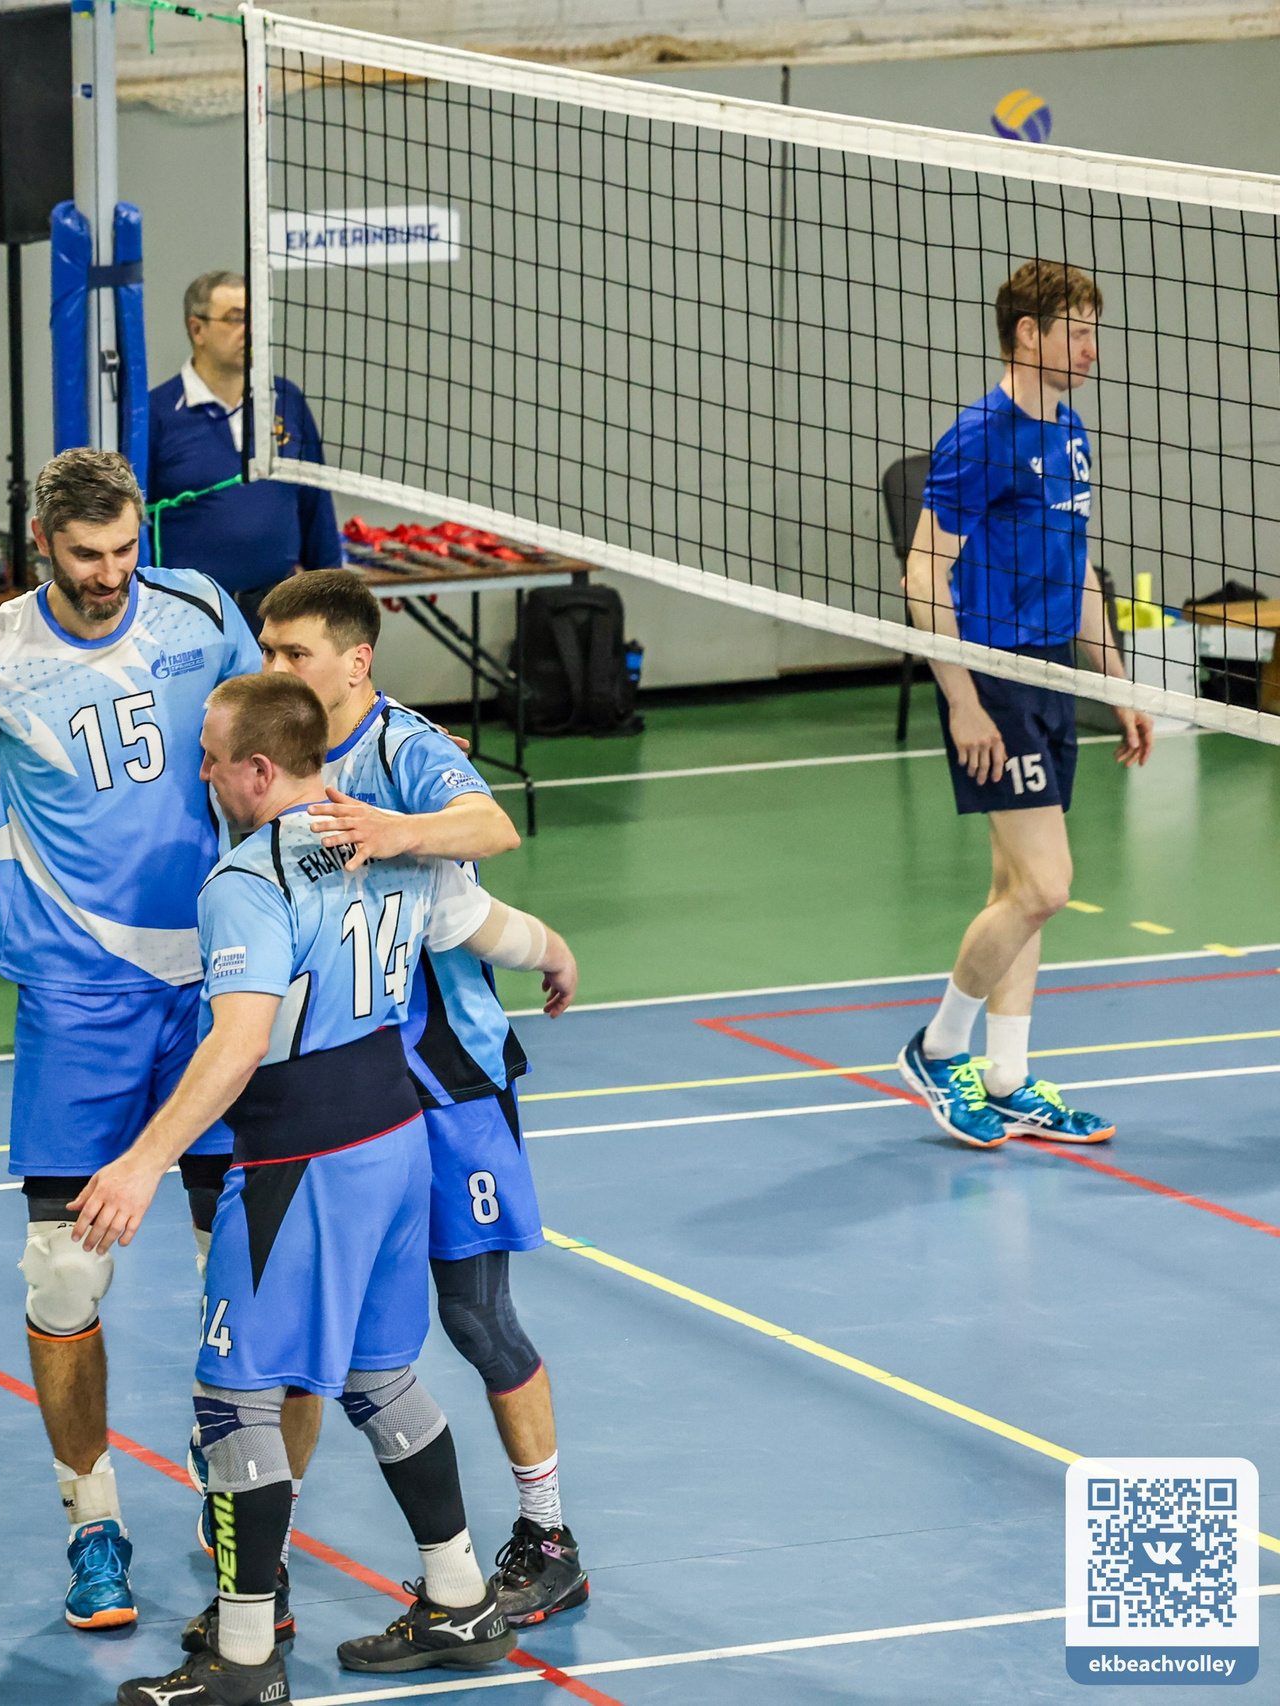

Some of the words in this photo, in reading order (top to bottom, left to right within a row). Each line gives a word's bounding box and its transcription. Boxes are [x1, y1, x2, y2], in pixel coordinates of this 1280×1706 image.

[68, 689, 166, 792] 15
[1004, 752, 1047, 795] 15
[340, 890, 410, 1020] 14
[467, 1169, 501, 1226] 8
[212, 1491, 238, 1594] DEMI
